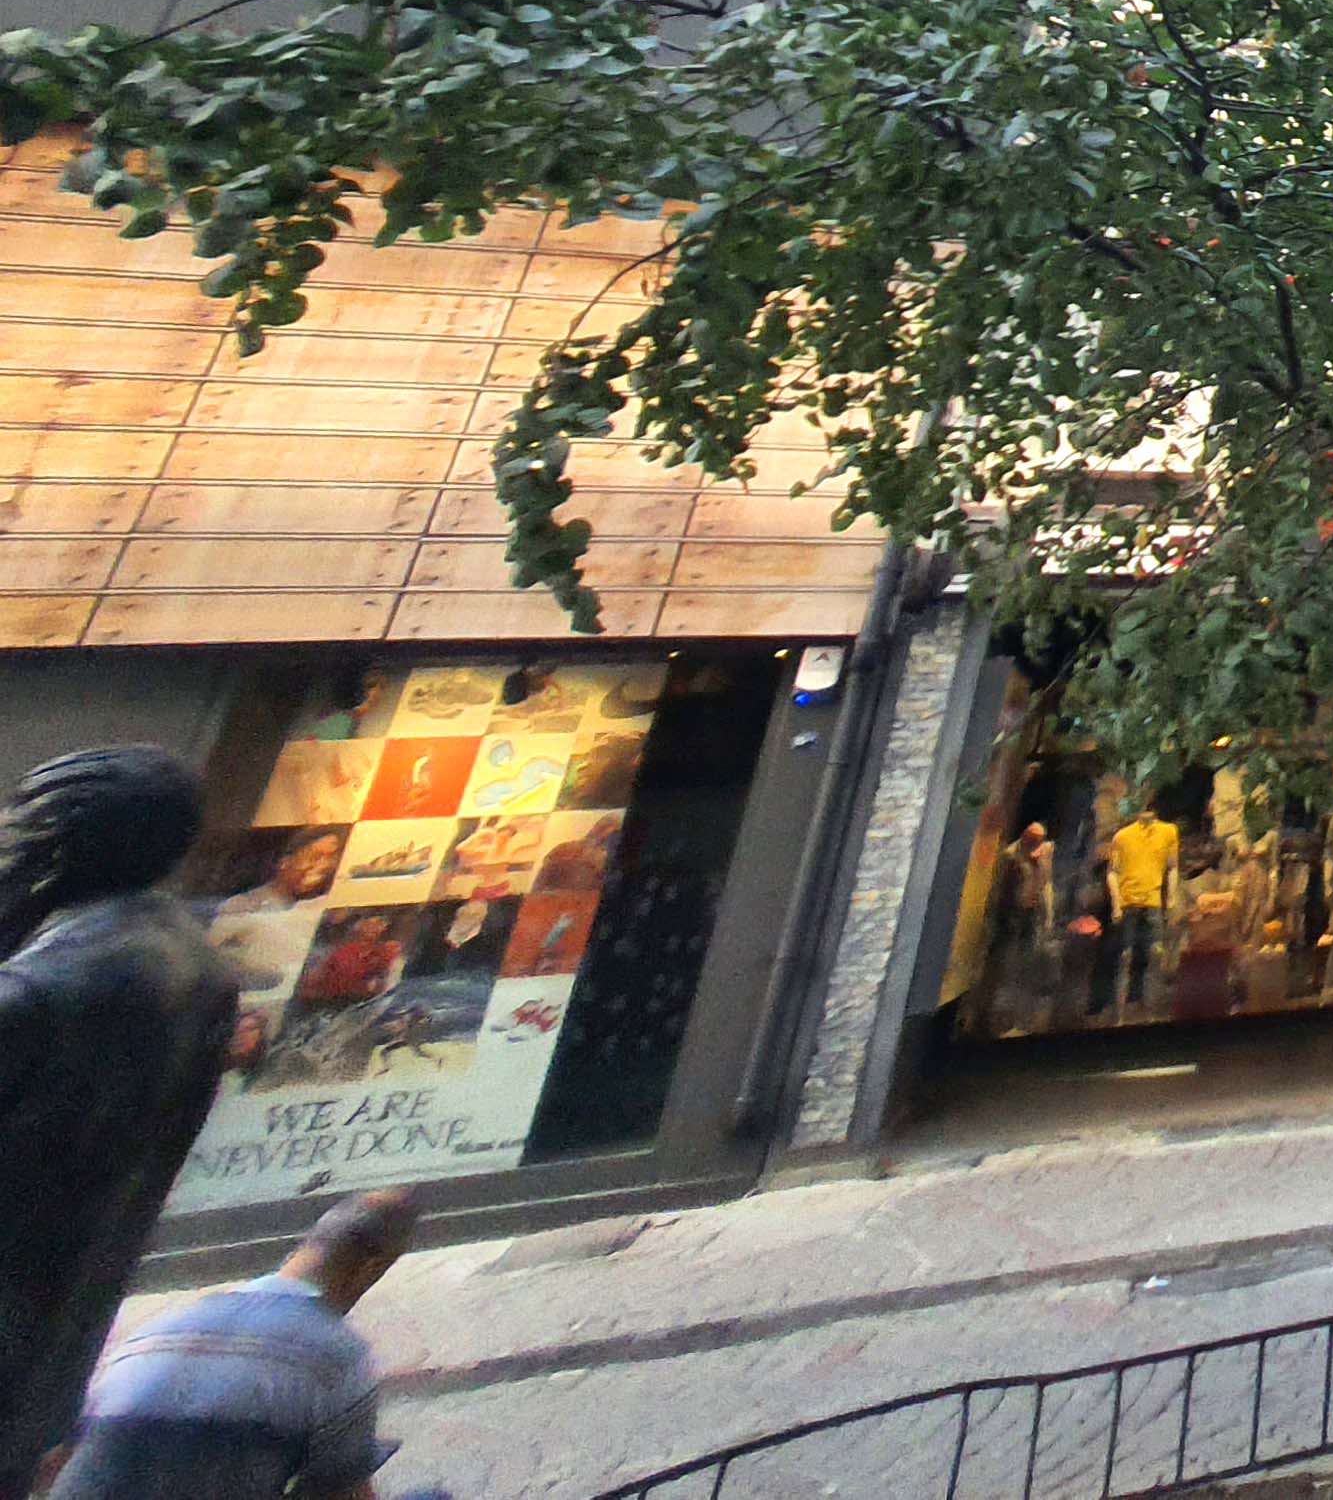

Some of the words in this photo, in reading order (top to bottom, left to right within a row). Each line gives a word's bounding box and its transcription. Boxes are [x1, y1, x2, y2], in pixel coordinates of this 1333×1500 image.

[265, 1096, 341, 1135] WE
[344, 1087, 440, 1127] ARE
[191, 1134, 339, 1180] NEVER
